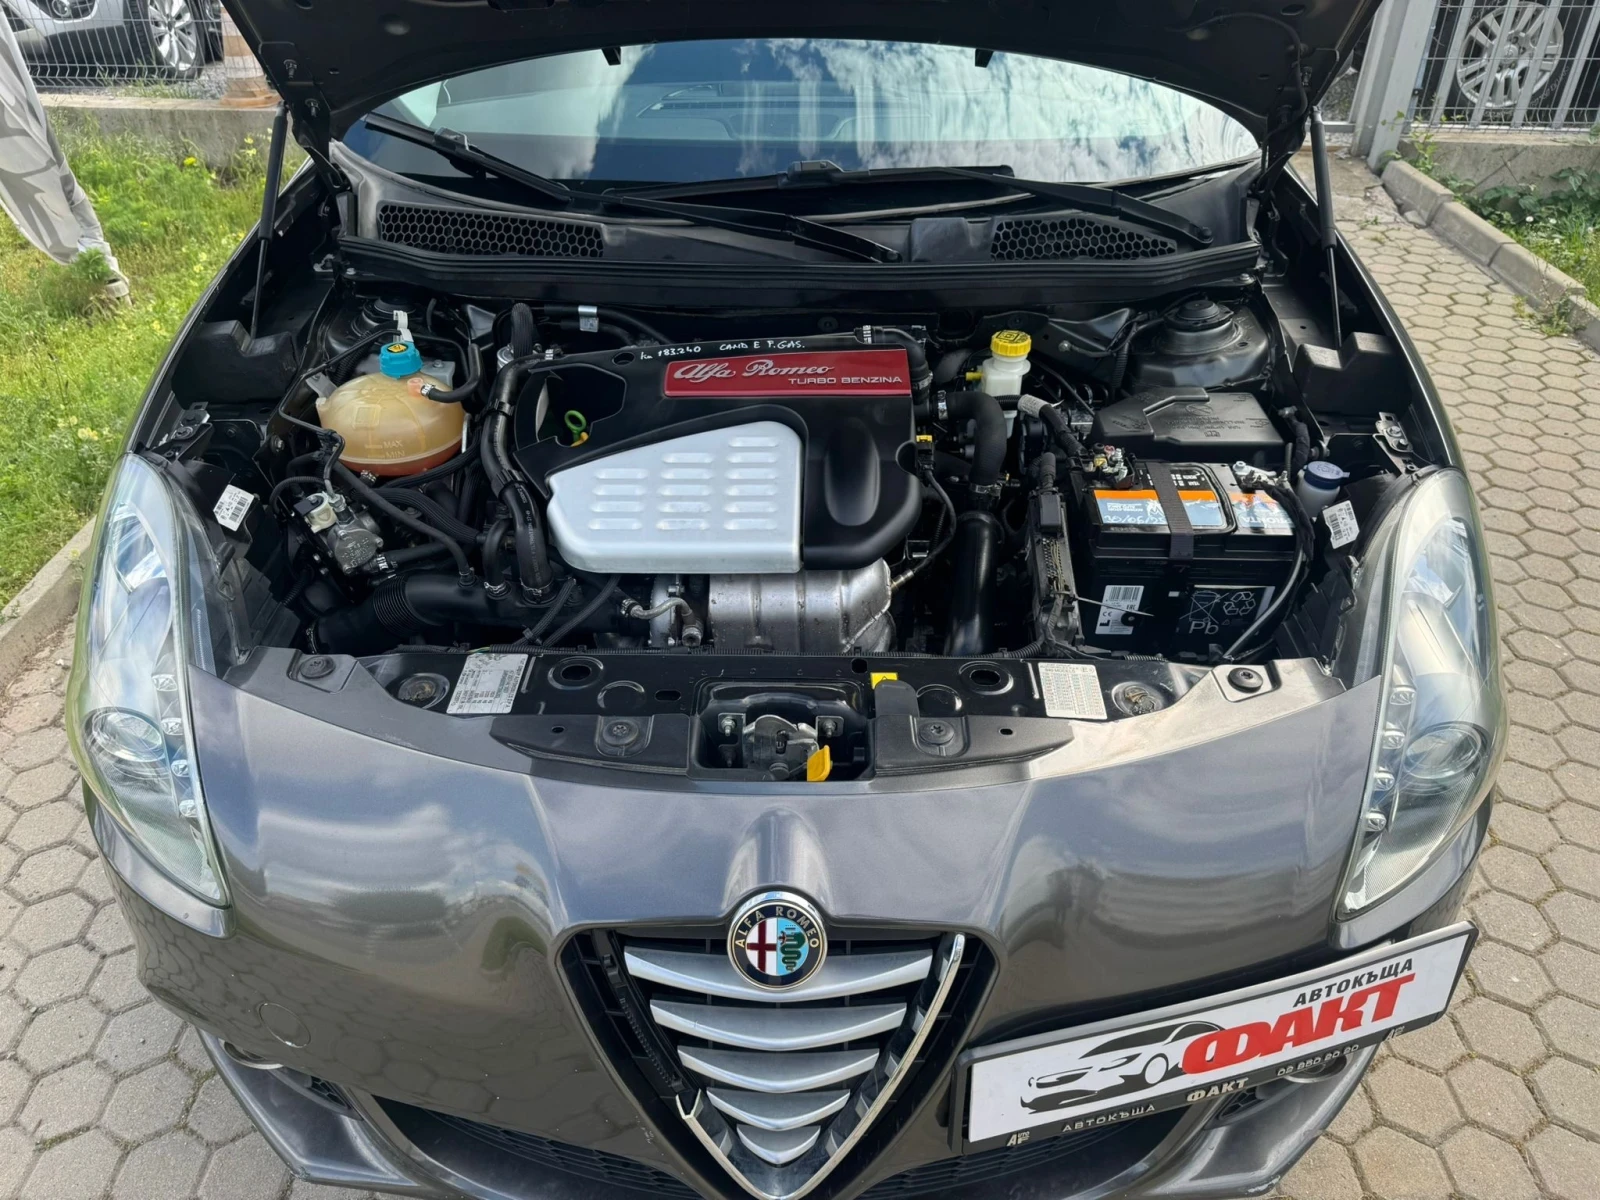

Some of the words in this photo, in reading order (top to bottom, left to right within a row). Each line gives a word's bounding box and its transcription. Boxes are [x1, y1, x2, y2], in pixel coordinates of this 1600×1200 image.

[753, 341, 761, 349] E
[673, 362, 736, 383] Alfa
[742, 359, 835, 378] Romeo
[788, 377, 837, 385] TURBO
[841, 376, 903, 384] BENZINA
[383, 440, 403, 449] MAX
[385, 451, 405, 459] MIN
[1189, 621, 1219, 635] Pb
[735, 910, 766, 948] ALFA
[775, 906, 820, 948] ROMEO
[1293, 958, 1413, 1007] АВТОКЪЩА
[1181, 973, 1416, 1074] ФАКТ
[1277, 1065, 1294, 1076] 02
[1186, 1077, 1249, 1102] ФАКТ
